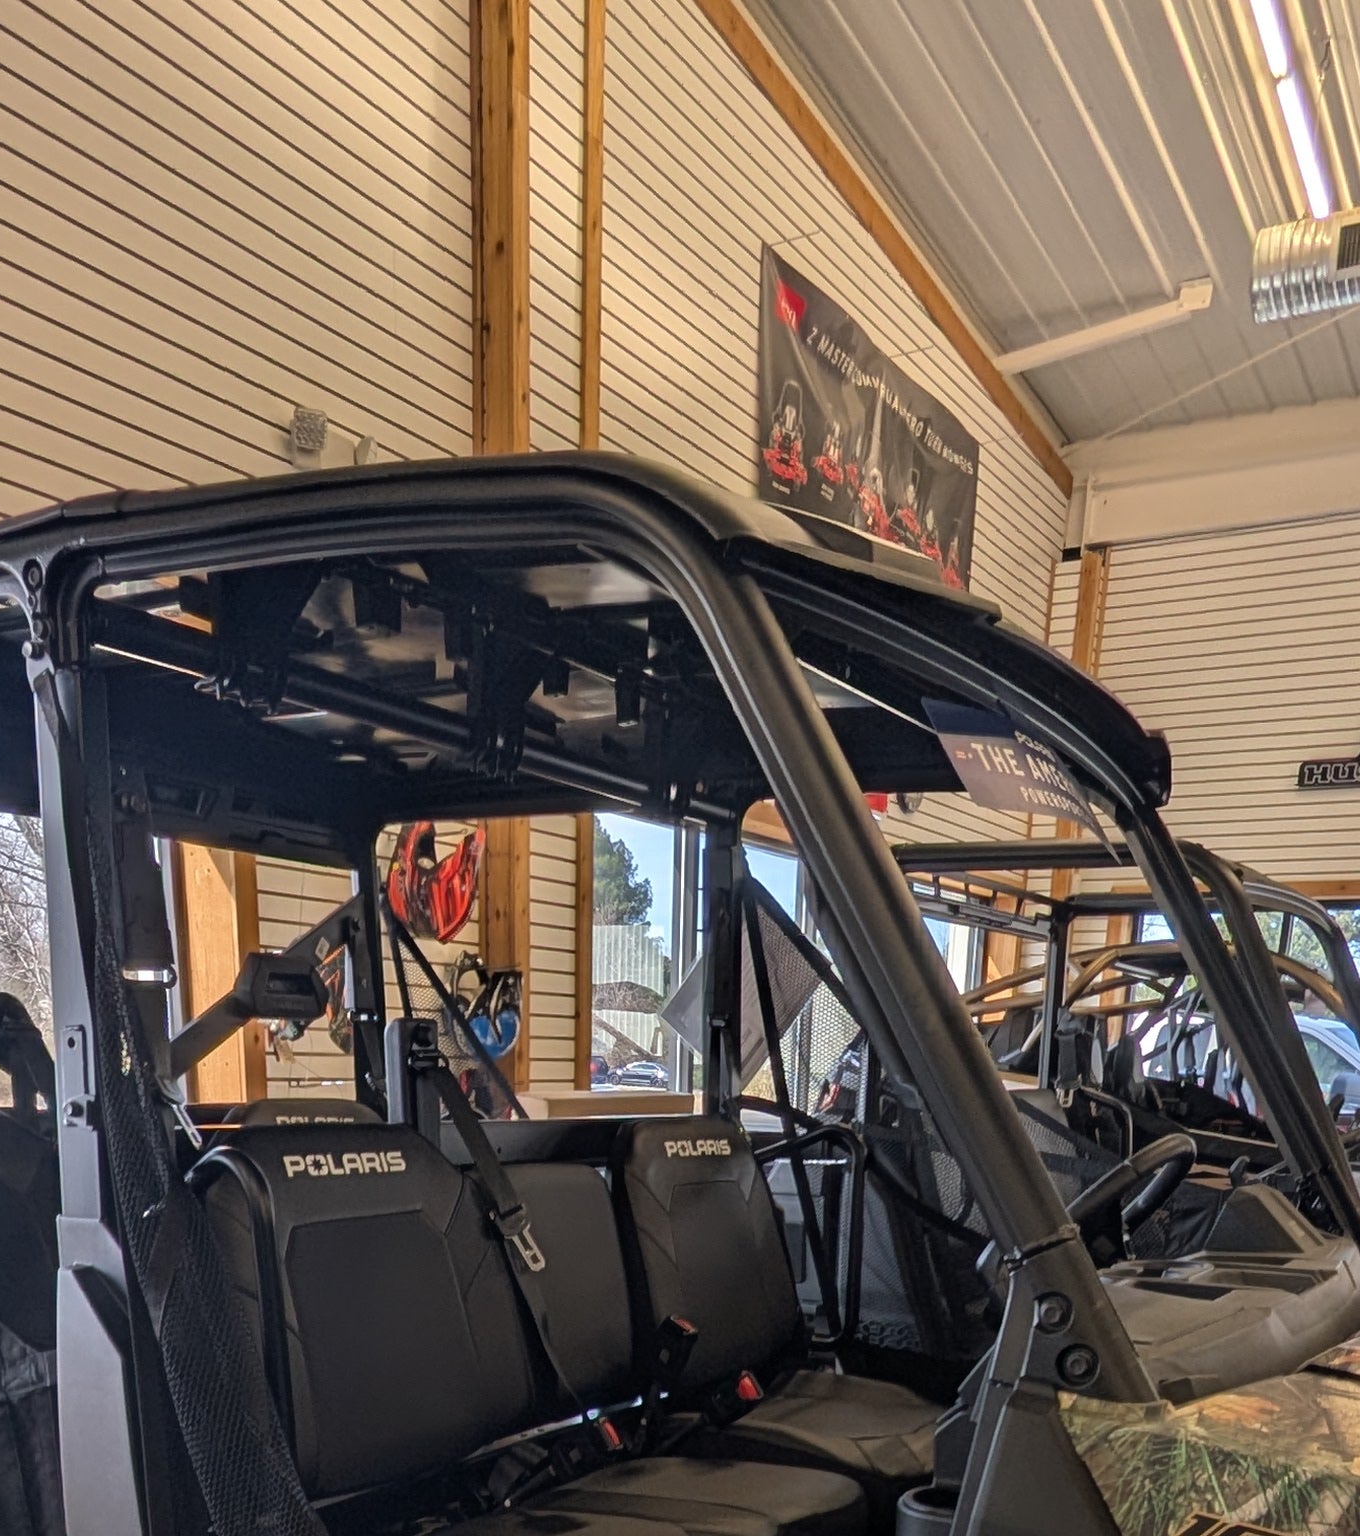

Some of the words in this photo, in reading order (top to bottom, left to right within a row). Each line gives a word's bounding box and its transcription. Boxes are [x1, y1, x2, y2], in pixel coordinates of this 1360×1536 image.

[817, 333, 855, 379] MASTER
[851, 368, 905, 417] COMMRCIAL
[970, 742, 1025, 777] THE
[282, 1150, 407, 1178] POLARIS
[664, 1139, 732, 1158] POLARIS
